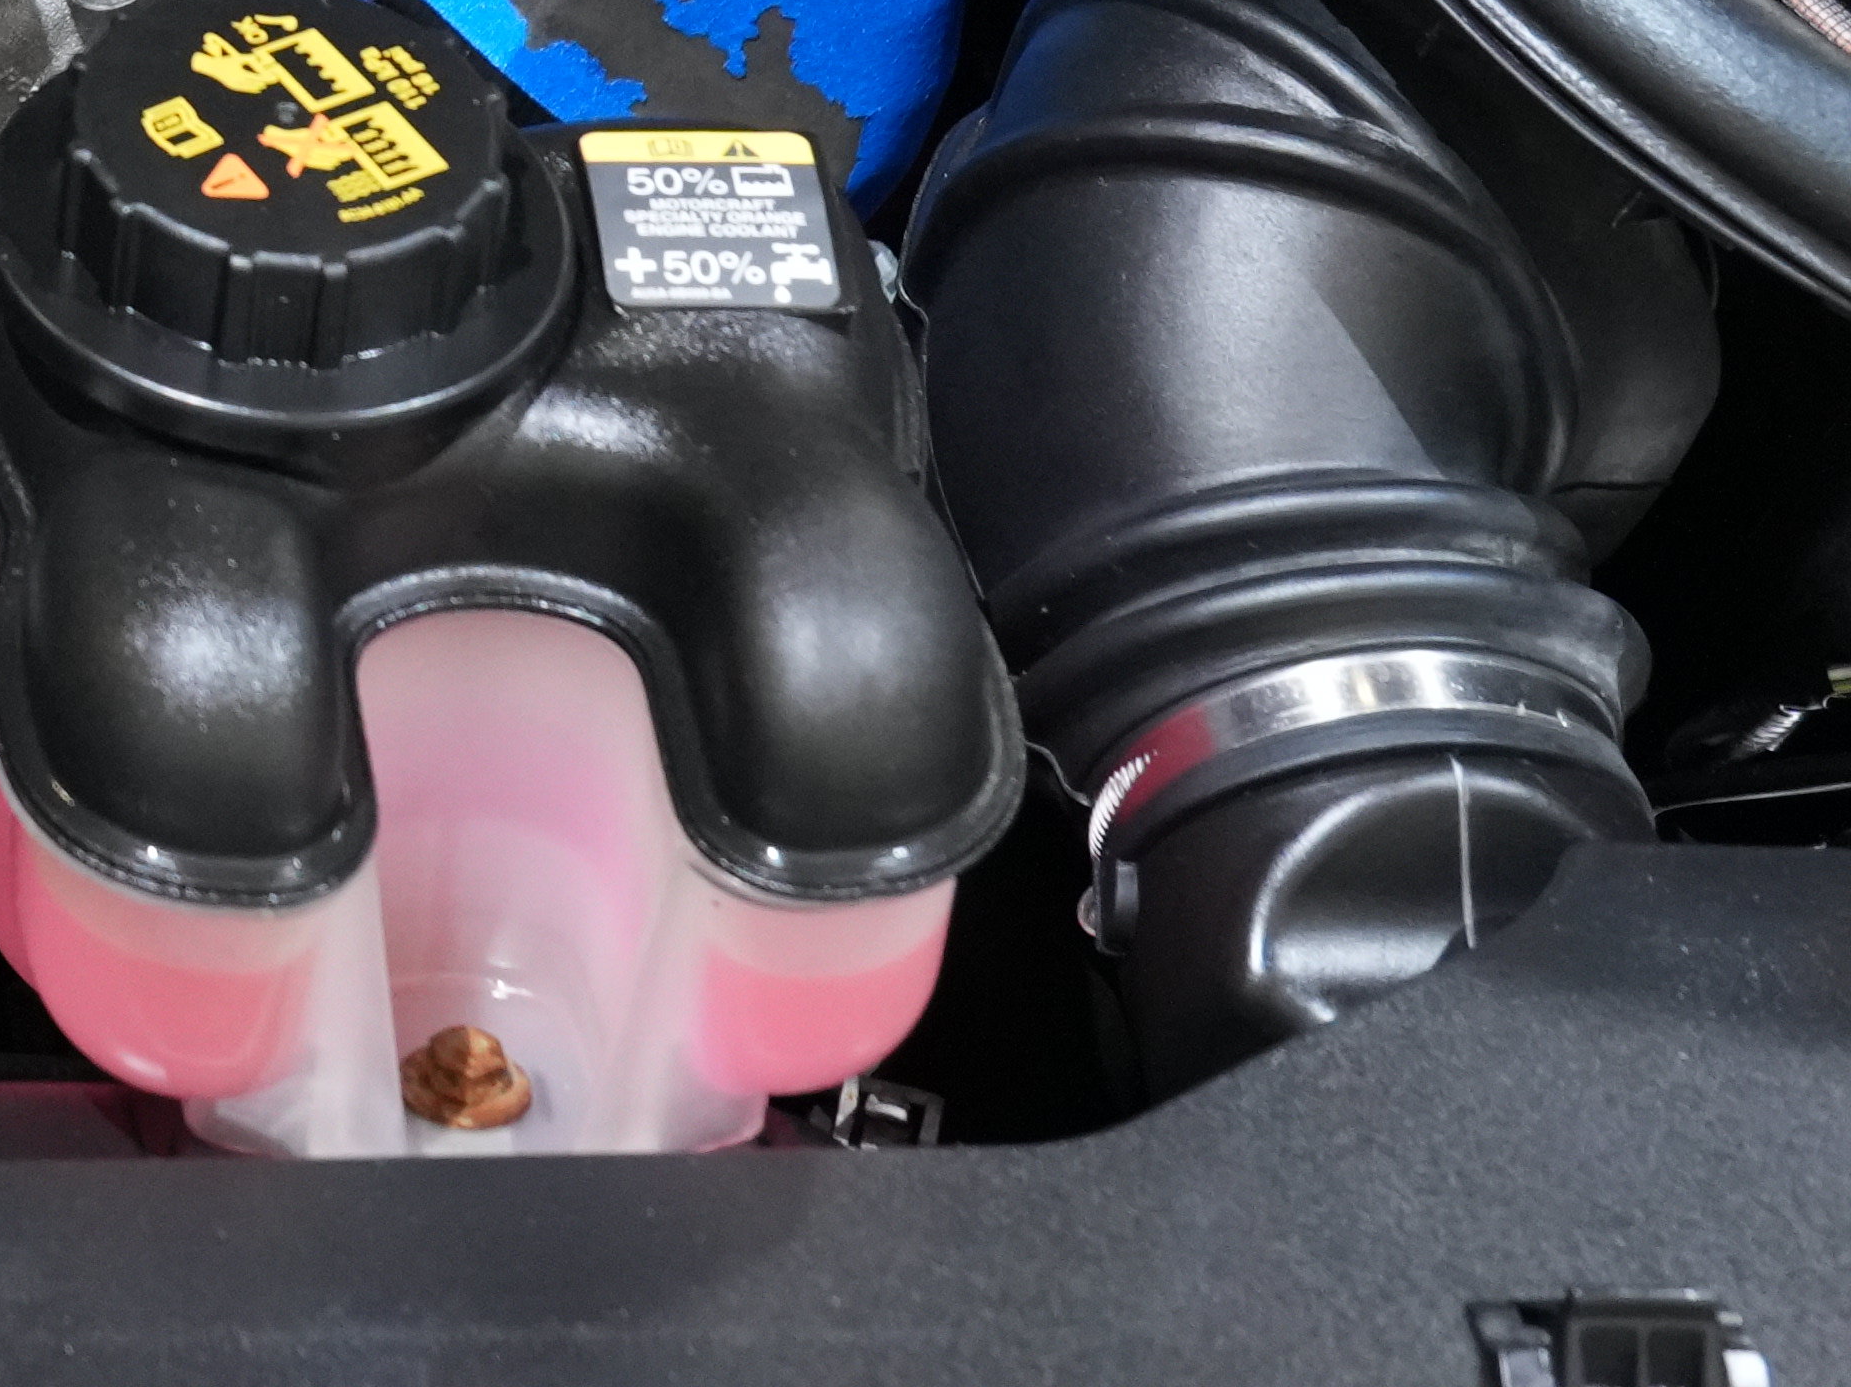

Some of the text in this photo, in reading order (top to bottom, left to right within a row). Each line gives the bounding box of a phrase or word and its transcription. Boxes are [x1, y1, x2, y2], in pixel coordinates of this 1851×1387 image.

[626, 166, 729, 196] 50%
[649, 198, 776, 212] MOTORCRAFT
[623, 209, 808, 226] SPECIALTY ORANGE
[635, 223, 798, 239] ENGINE COOLANT
